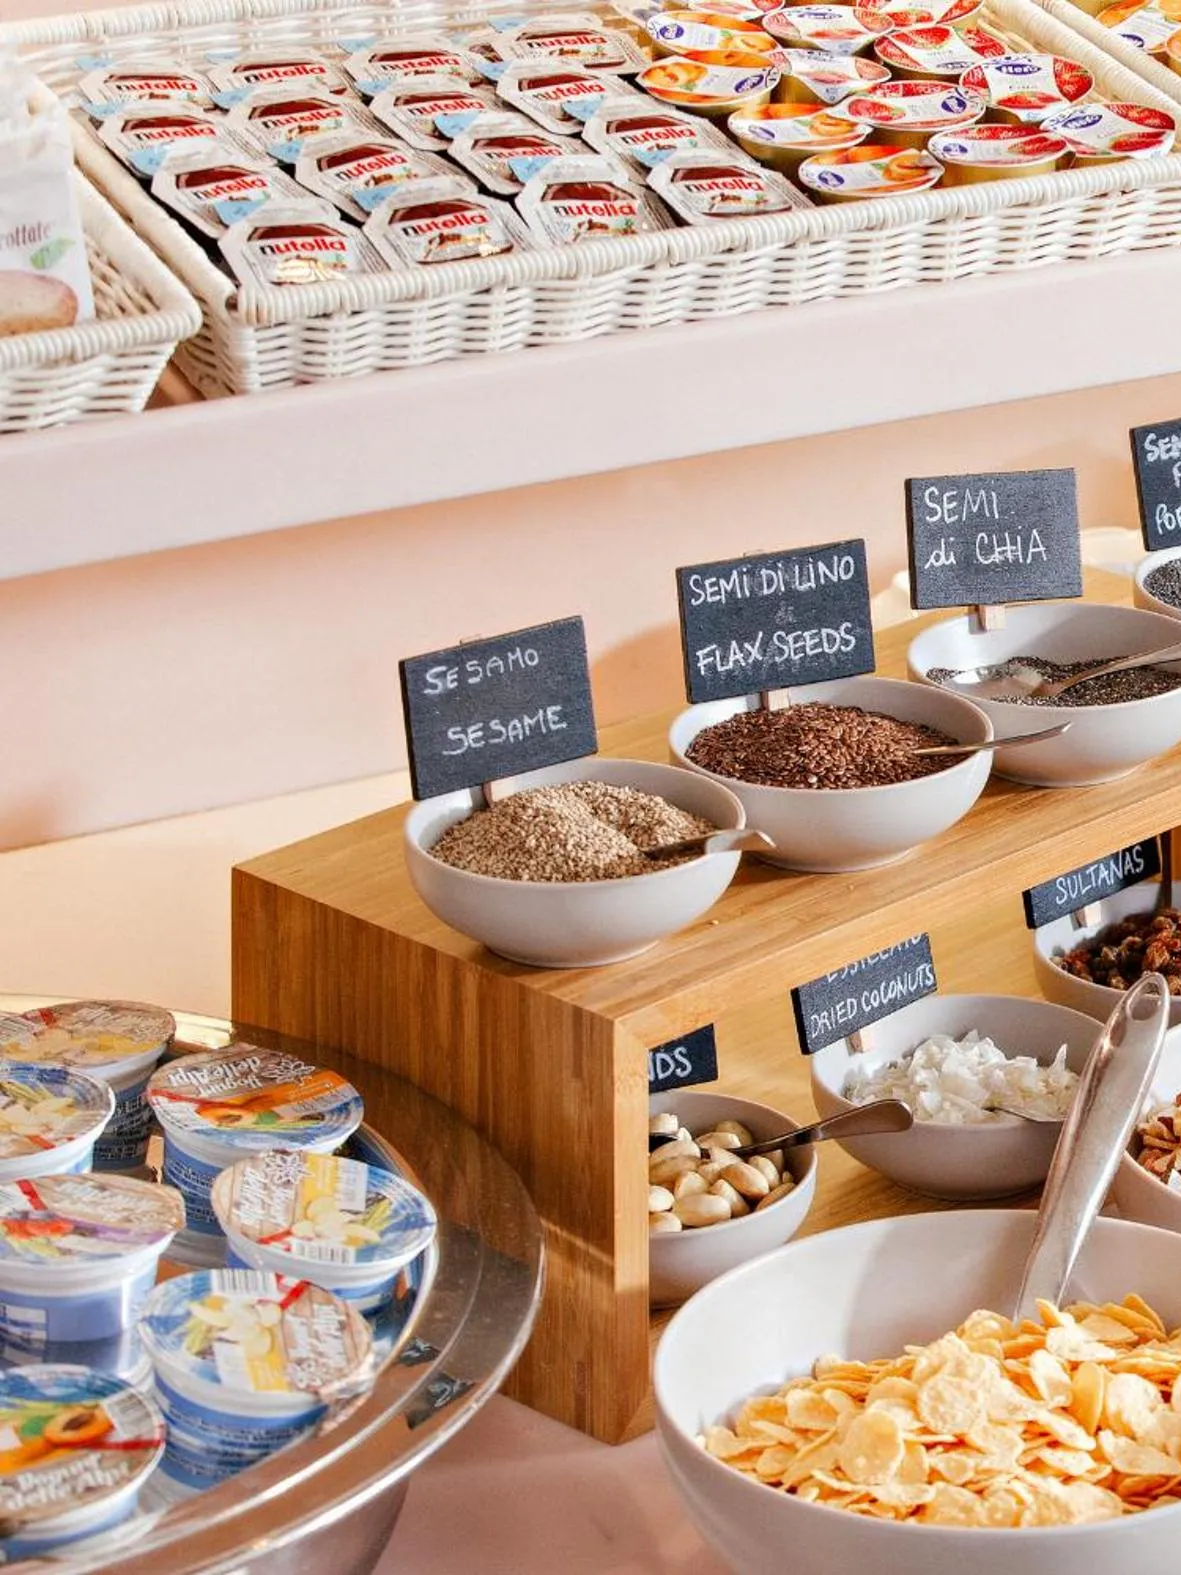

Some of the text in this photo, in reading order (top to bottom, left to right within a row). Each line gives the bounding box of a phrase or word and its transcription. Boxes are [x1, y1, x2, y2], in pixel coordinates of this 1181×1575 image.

[527, 35, 607, 48] nutella
[244, 65, 326, 83] nutella
[381, 57, 460, 71] nutella
[262, 108, 344, 129] nutella
[407, 100, 484, 115] nutella
[136, 124, 216, 141] nutella
[622, 127, 697, 146] nutella
[335, 154, 407, 180] nutella
[193, 177, 268, 200] nutella
[684, 177, 763, 193] nutella
[555, 200, 637, 217] nutella
[402, 212, 488, 236] nutella
[259, 237, 347, 255] nutella
[924, 480, 999, 523] SEMI
[924, 526, 1047, 569] di CHIA
[689, 556, 855, 606] SEMI DI LINO
[696, 622, 856, 676] FLAX SEEDS
[442, 705, 568, 756] SESAME
[1055, 845, 1144, 905] SULTANAS
[810, 963, 934, 1038] DRIED COCONUTS
